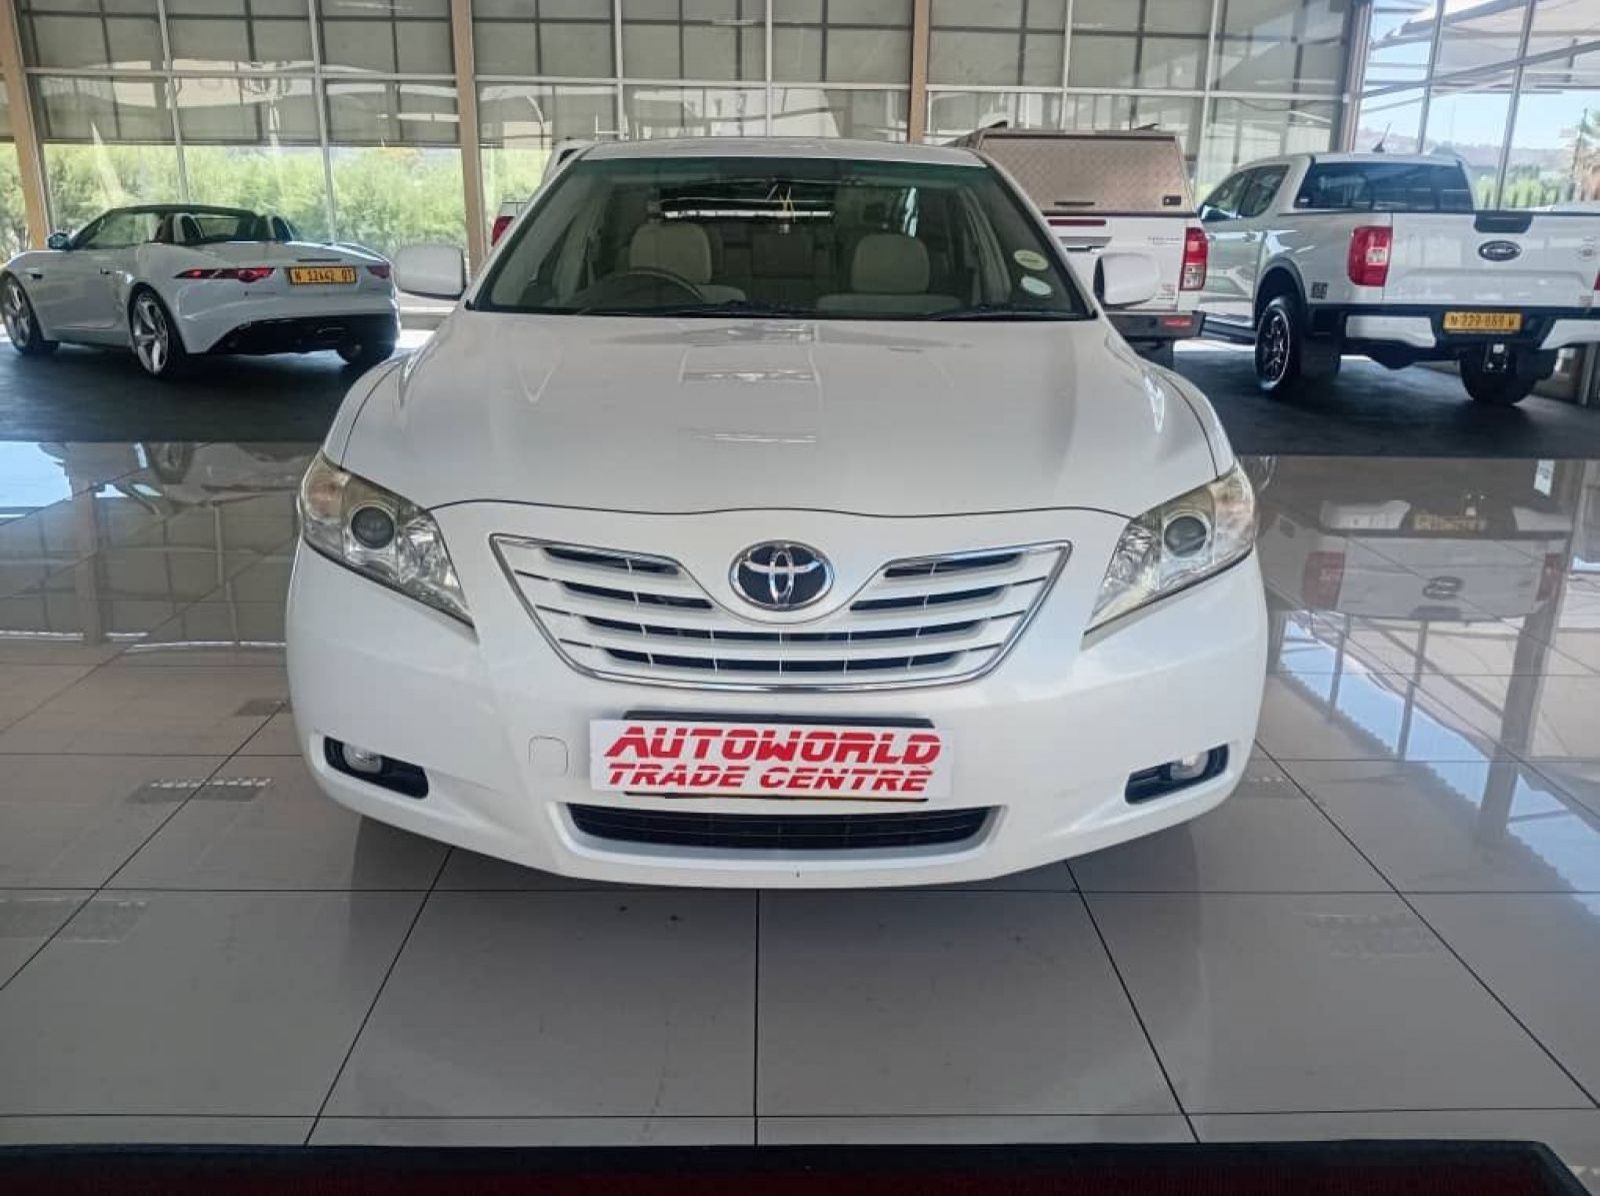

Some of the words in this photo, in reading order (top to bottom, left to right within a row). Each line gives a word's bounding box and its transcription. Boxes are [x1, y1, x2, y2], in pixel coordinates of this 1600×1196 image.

[604, 726, 941, 765] AUTOWORLD
[608, 763, 750, 788] TRADE
[759, 766, 935, 792] CENTRE
